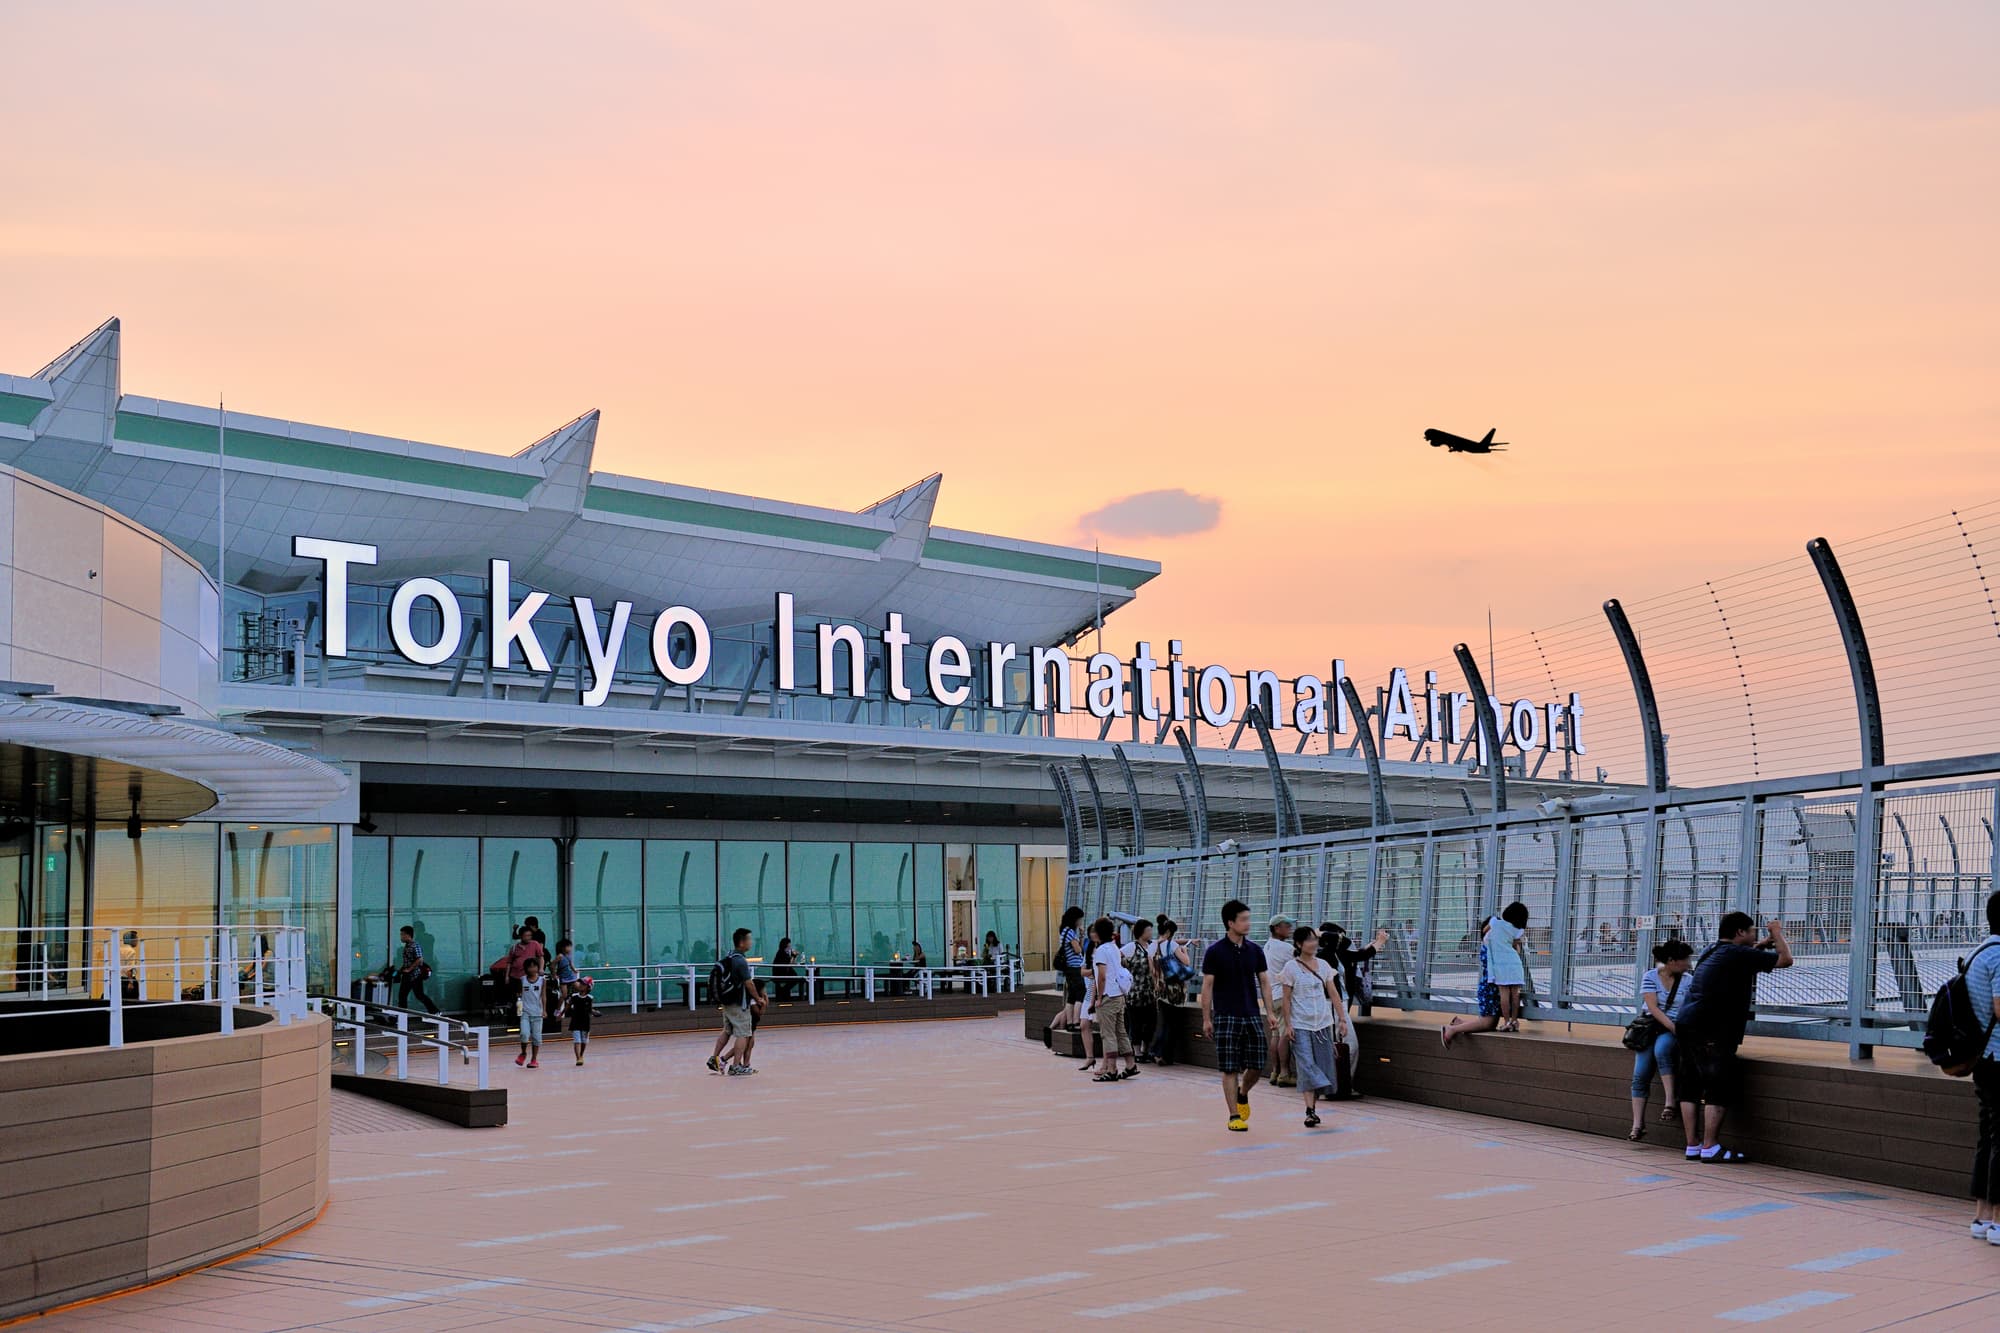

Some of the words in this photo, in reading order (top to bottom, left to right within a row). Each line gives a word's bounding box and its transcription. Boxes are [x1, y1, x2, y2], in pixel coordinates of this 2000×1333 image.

[291, 536, 712, 706] Tokyo
[775, 592, 1347, 734] International
[1384, 667, 1586, 766] Airport
